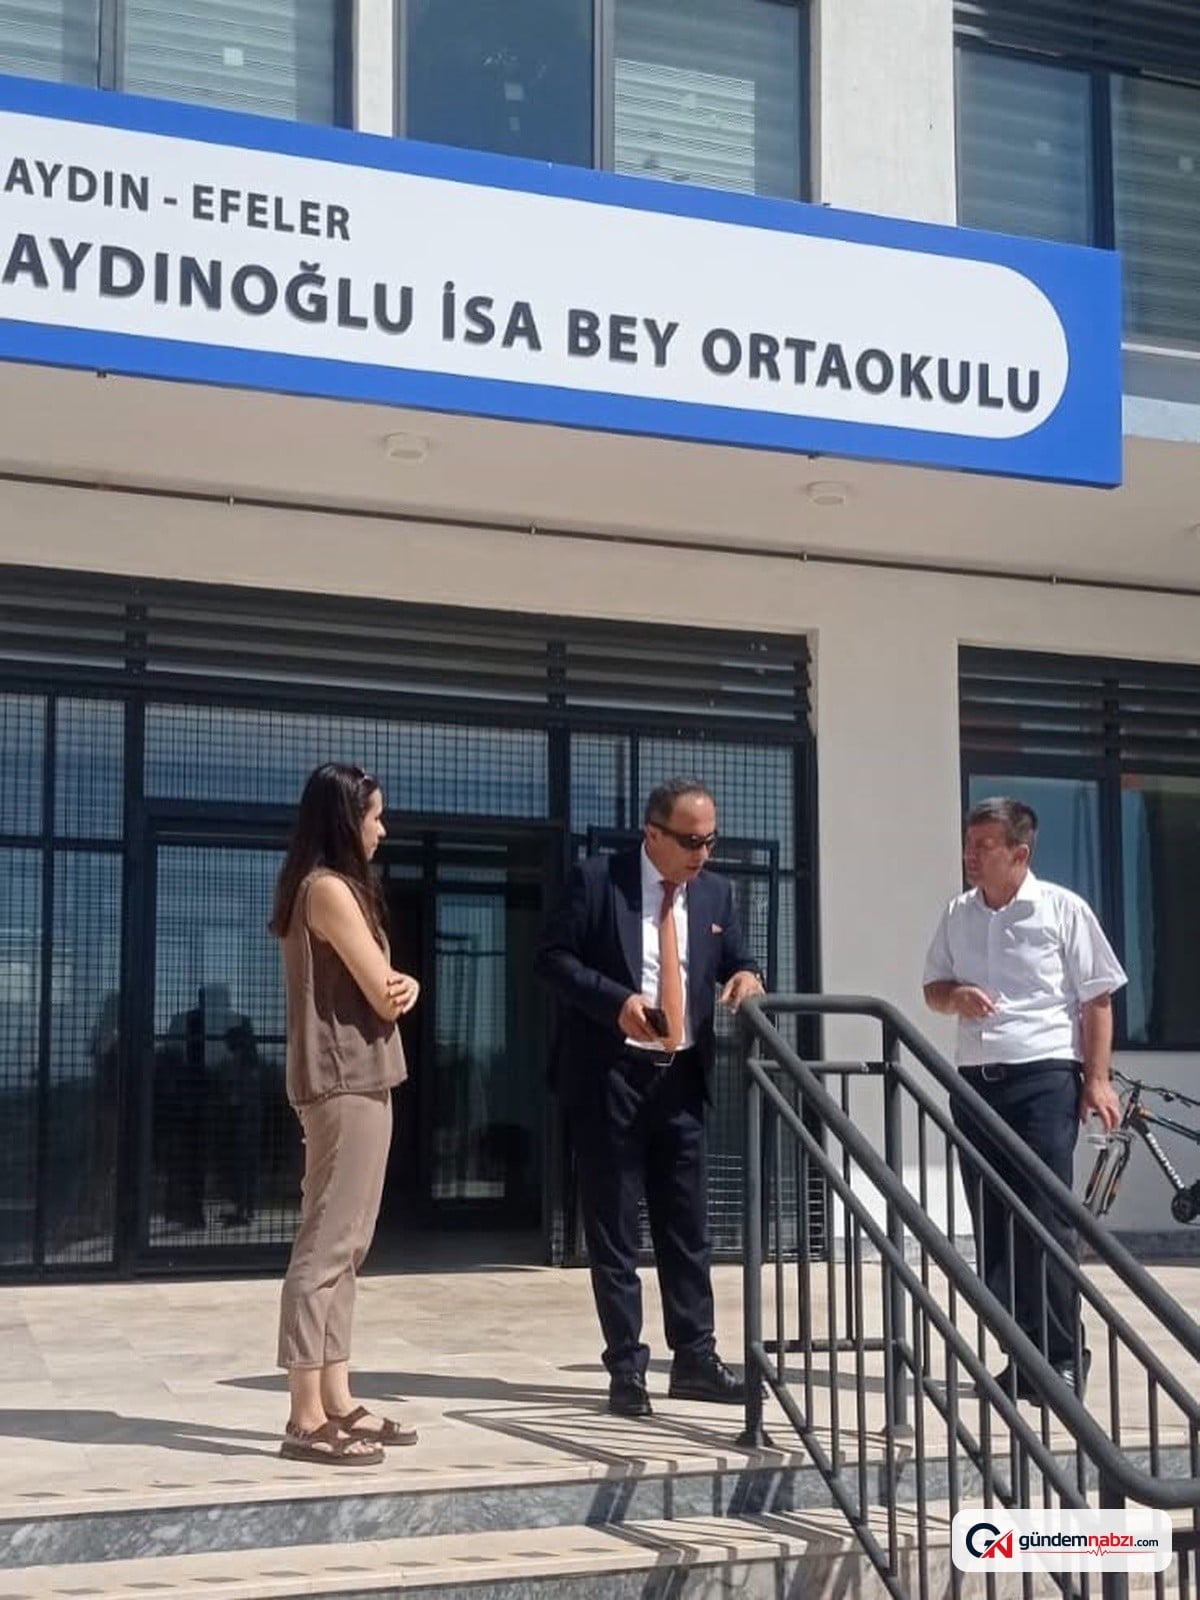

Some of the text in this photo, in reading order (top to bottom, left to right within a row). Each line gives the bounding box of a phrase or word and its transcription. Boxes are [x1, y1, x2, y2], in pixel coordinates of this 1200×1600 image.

[4, 157, 351, 241] AYDIN - EFELER
[2, 233, 1040, 413] AYDINOĞLU İSA BEY ORTAOKULU
